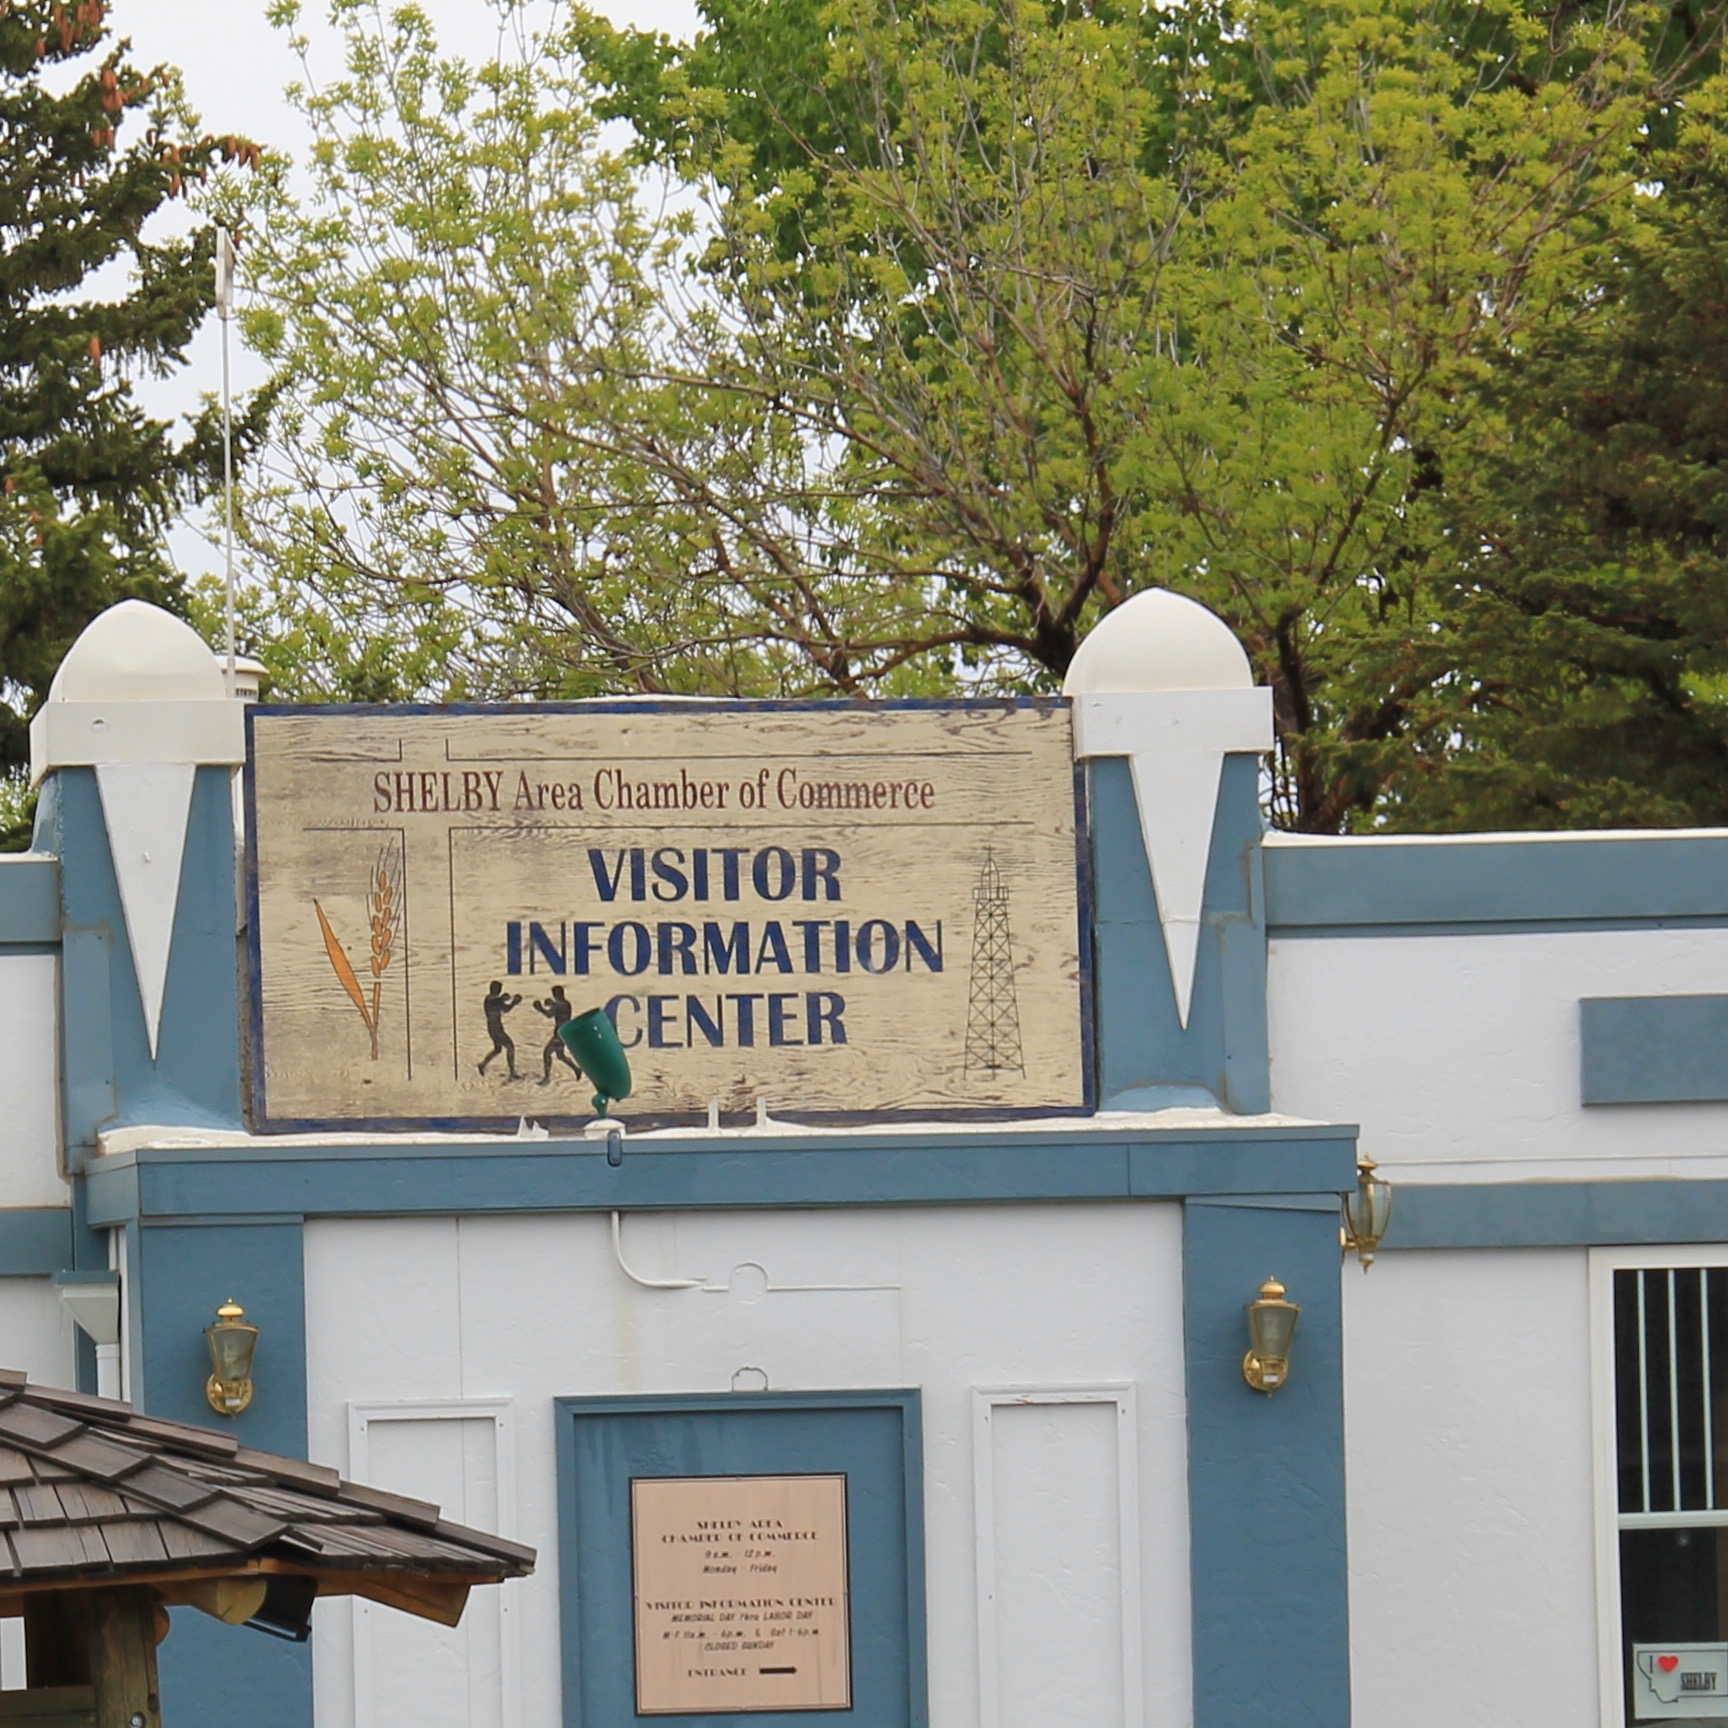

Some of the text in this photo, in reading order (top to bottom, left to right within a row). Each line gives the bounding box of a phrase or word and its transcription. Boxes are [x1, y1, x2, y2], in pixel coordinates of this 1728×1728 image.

[373, 767, 936, 813] SHELBY Area Chamber of Commerce
[588, 846, 842, 902] VISITOR
[506, 918, 944, 976] INFORMATION
[606, 992, 848, 1048] CENTER
[696, 1519, 783, 1530] SHELBY AREA
[661, 1531, 819, 1544] CHAMBER OF COMMERCE
[703, 1564, 737, 1575] Monday
[749, 1563, 778, 1574] Friday
[645, 1597, 837, 1611] VISITOR INFORMATION CENTER
[671, 1612, 715, 1623] MEMORIAL
[718, 1612, 736, 1622] DAY
[763, 1610, 793, 1621] LABOR
[796, 1610, 814, 1620] DAY
[704, 1640, 775, 1651] CLOSED SUNDAY
[688, 1668, 747, 1677] ENTRANCE
[1680, 1672, 1717, 1690] SHELBY
